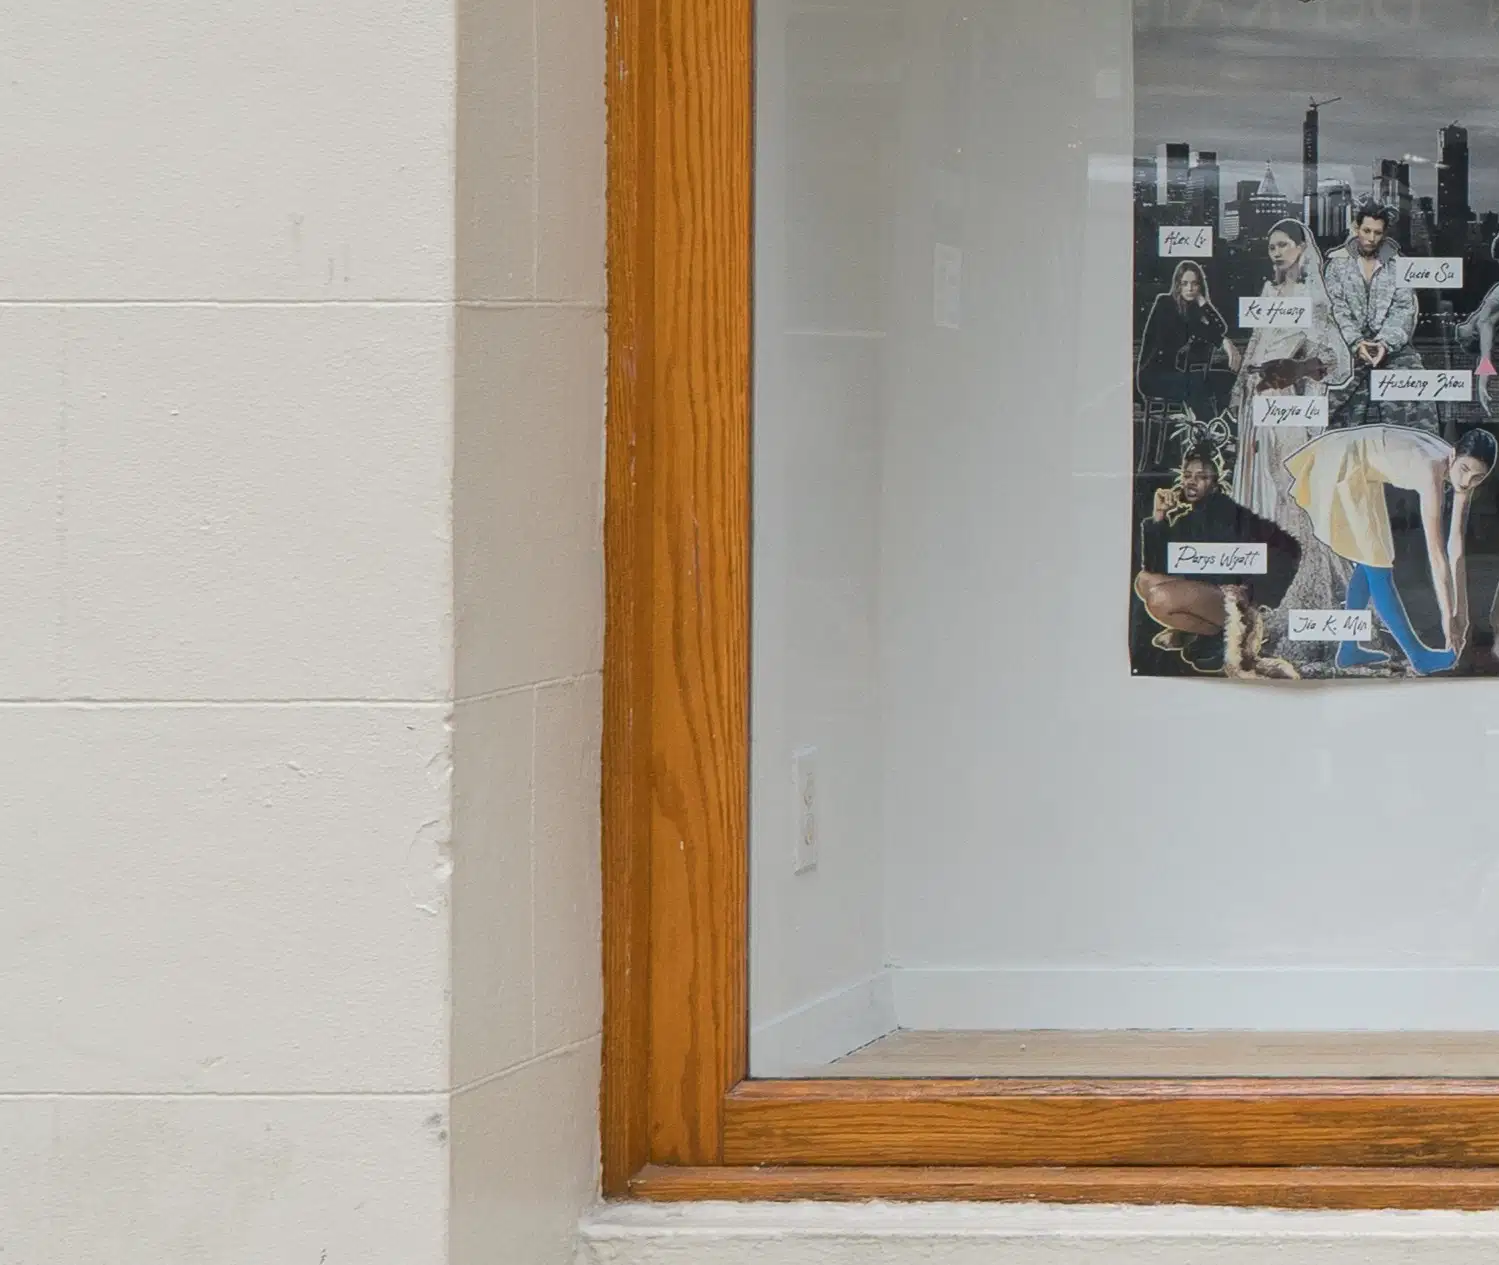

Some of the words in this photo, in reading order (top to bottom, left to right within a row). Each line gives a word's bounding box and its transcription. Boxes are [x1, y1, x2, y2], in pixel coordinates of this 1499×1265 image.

[1163, 230, 1190, 255] Alex
[1434, 262, 1456, 282] Su
[1244, 299, 1263, 321] Ke
[1266, 300, 1306, 325] Huang
[1433, 372, 1465, 398] Zhou
[1219, 547, 1261, 571] Wyatt
[1321, 614, 1337, 636] K.
